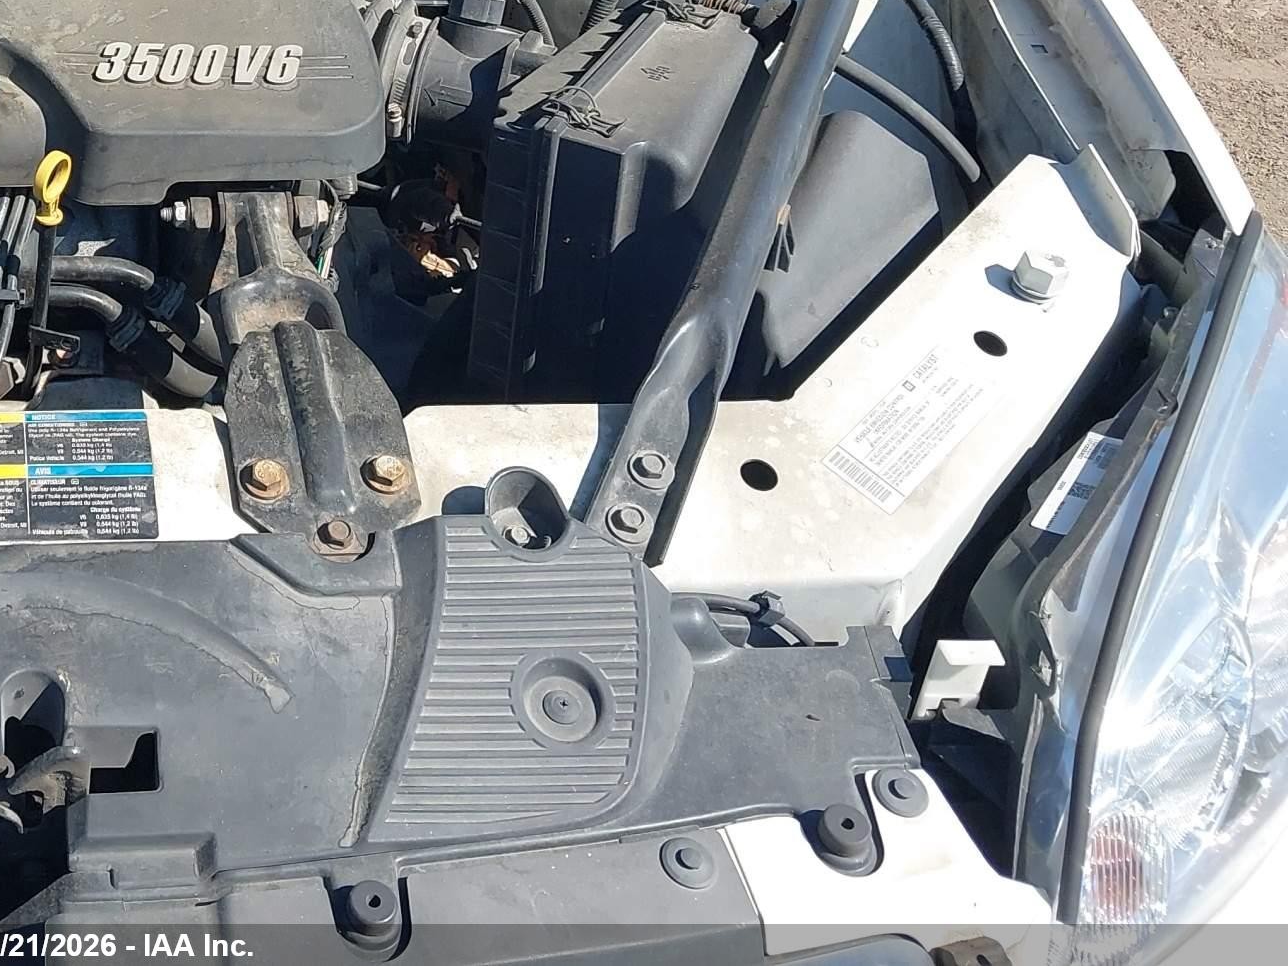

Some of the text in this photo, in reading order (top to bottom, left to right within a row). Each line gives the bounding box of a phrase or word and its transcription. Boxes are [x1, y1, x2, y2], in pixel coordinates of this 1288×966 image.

[92, 41, 304, 85] 3500 V6
[34, 467, 52, 475] AVIS
